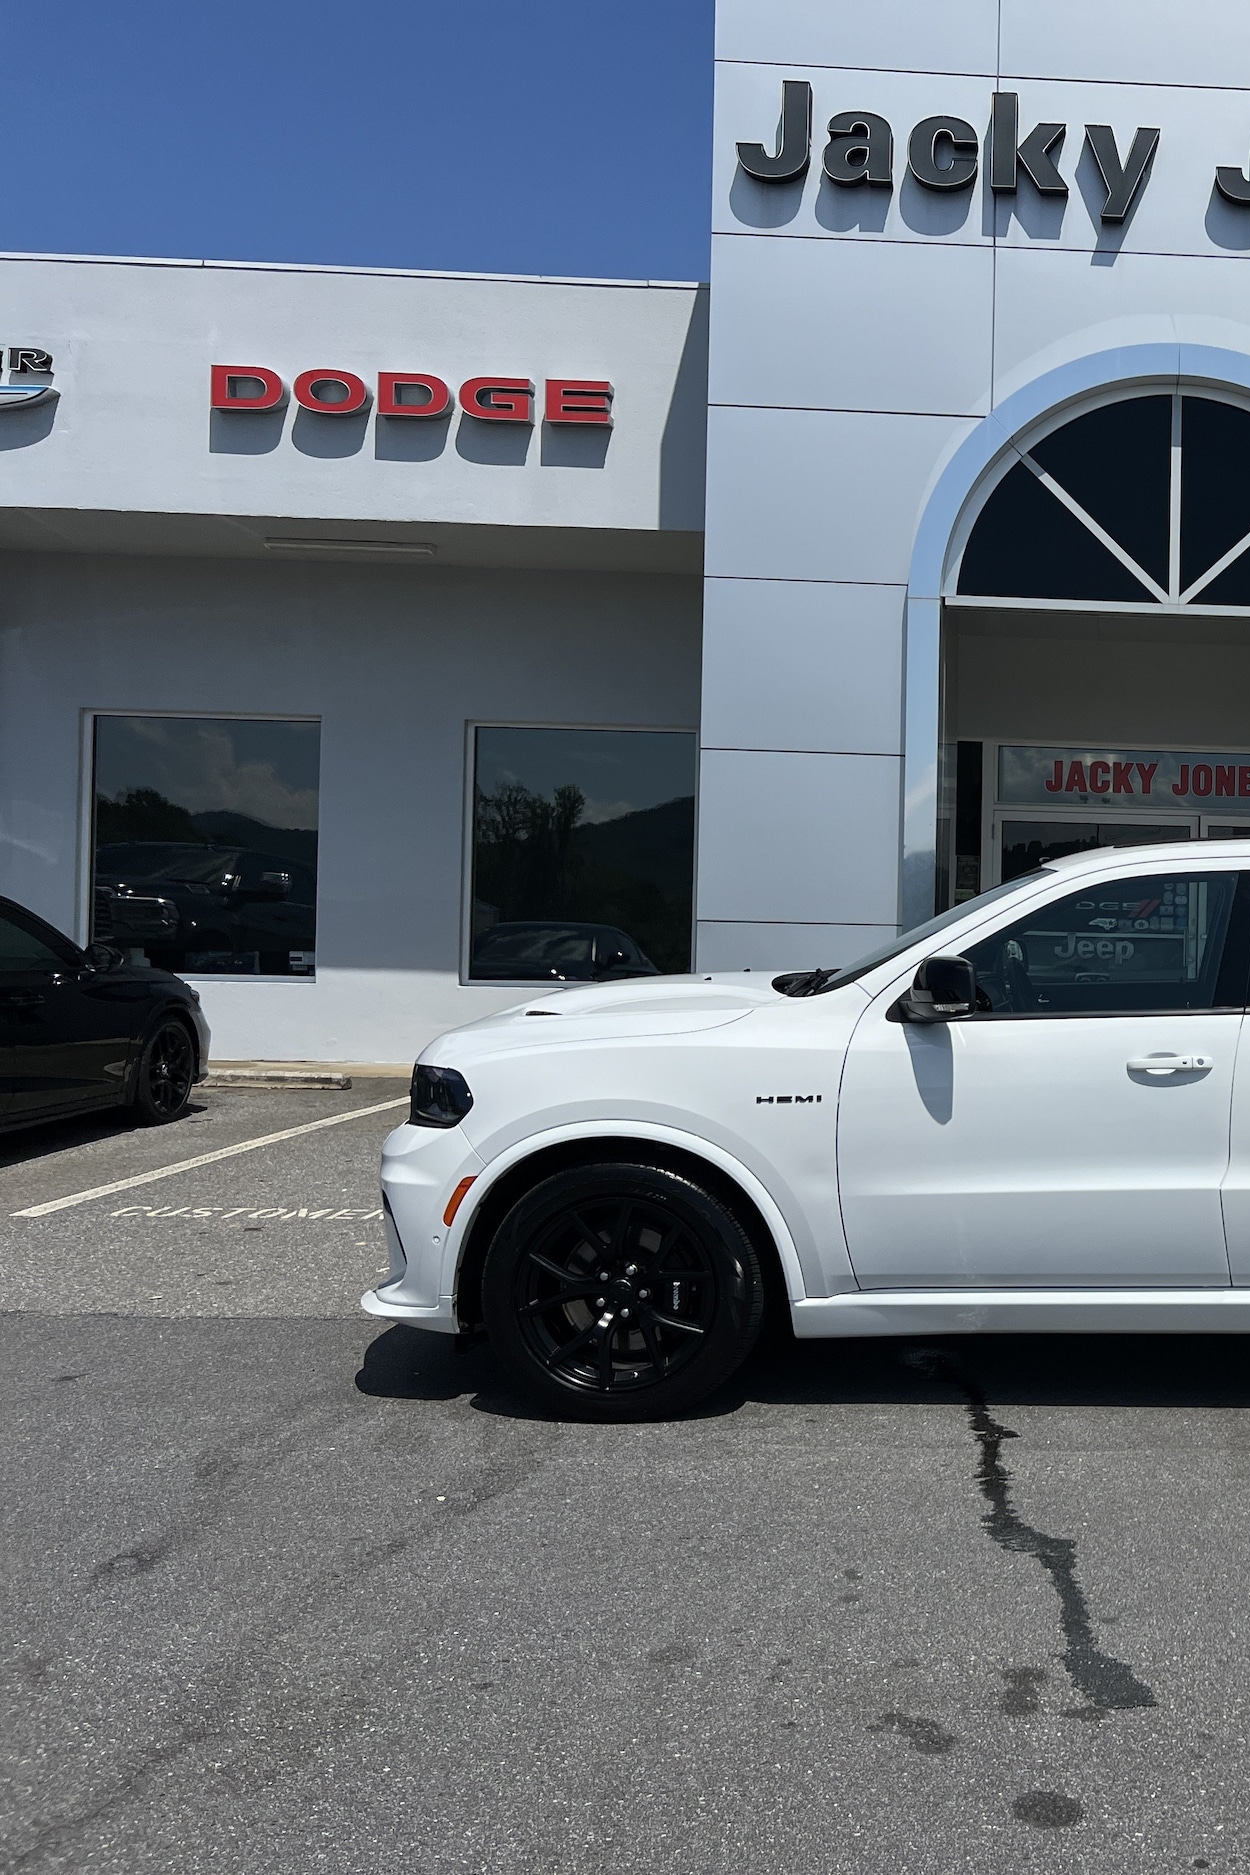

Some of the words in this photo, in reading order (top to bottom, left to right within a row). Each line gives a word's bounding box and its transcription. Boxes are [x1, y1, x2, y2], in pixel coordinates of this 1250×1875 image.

[736, 80, 1161, 223] Jacky
[210, 364, 614, 426] DODGE
[1045, 760, 1159, 795] JACKY
[1054, 932, 1135, 965] Jeep
[756, 1094, 822, 1104] HEMI
